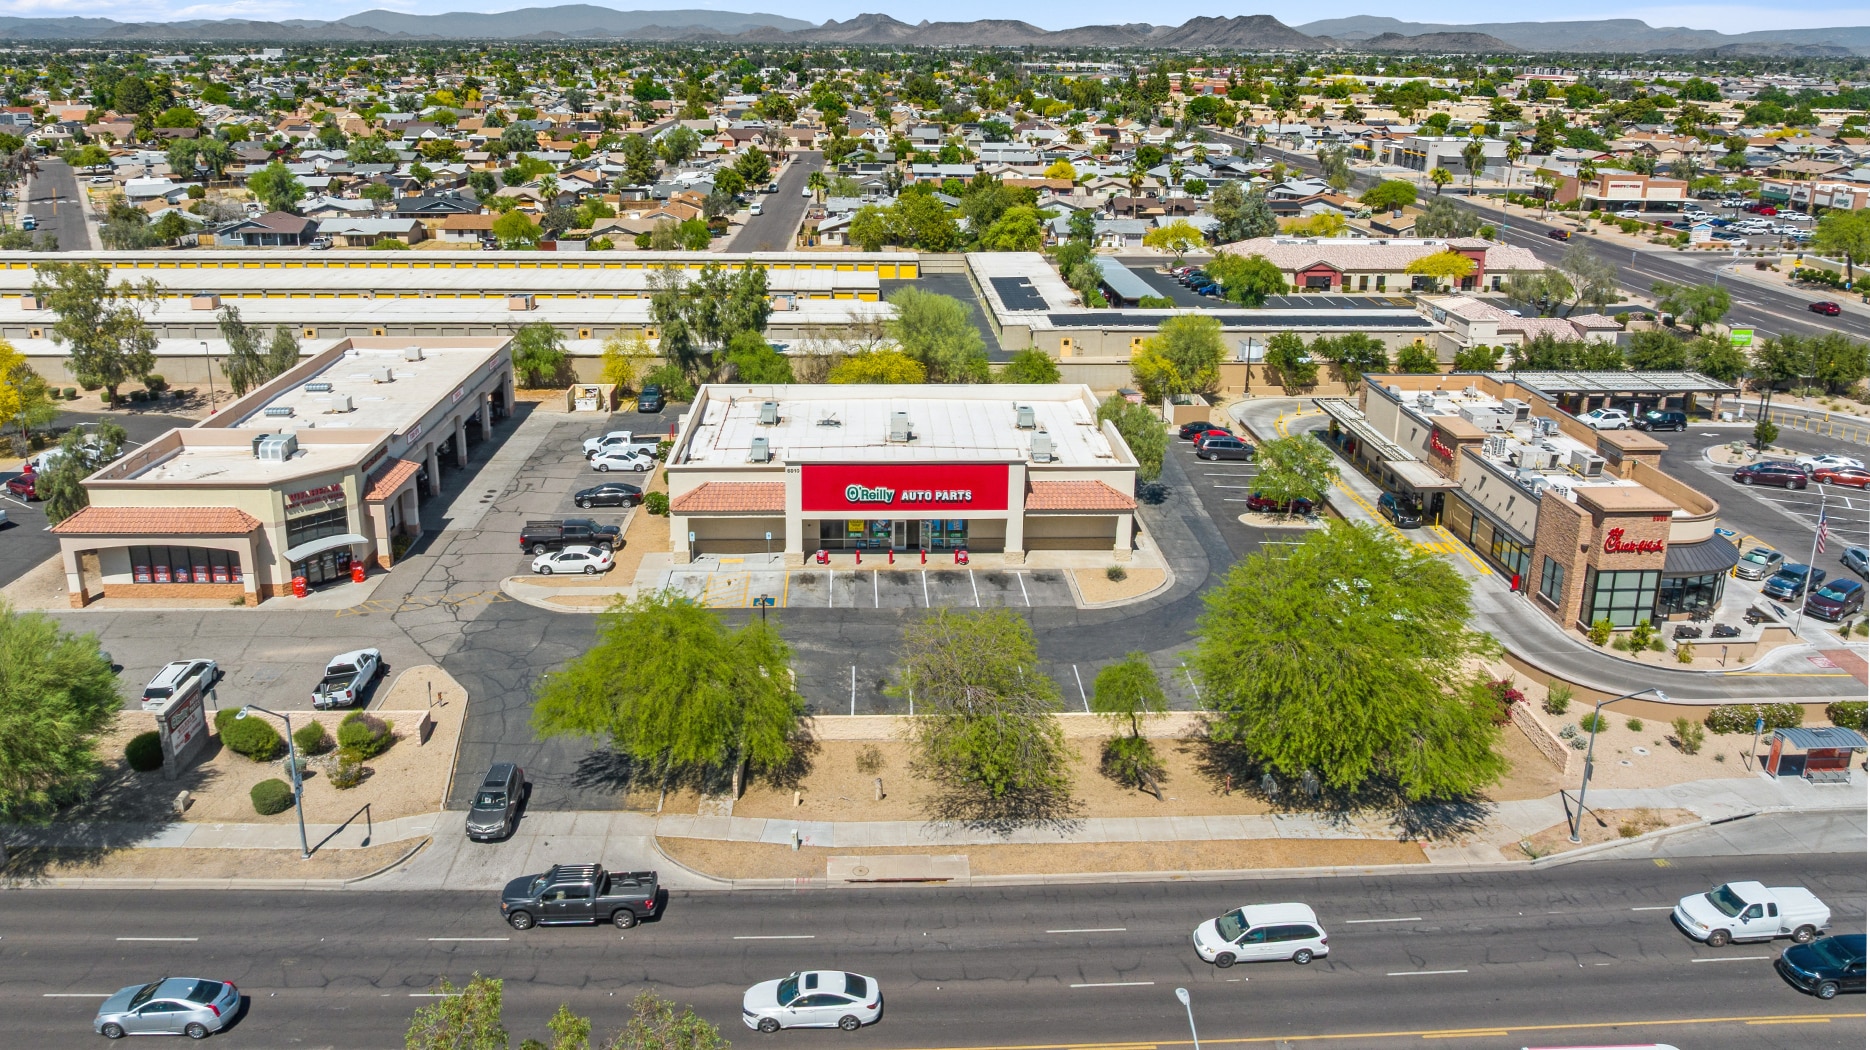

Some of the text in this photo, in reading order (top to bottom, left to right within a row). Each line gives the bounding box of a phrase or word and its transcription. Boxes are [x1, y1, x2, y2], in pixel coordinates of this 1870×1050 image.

[845, 484, 972, 502] O'Reilly AUTO PARTS
